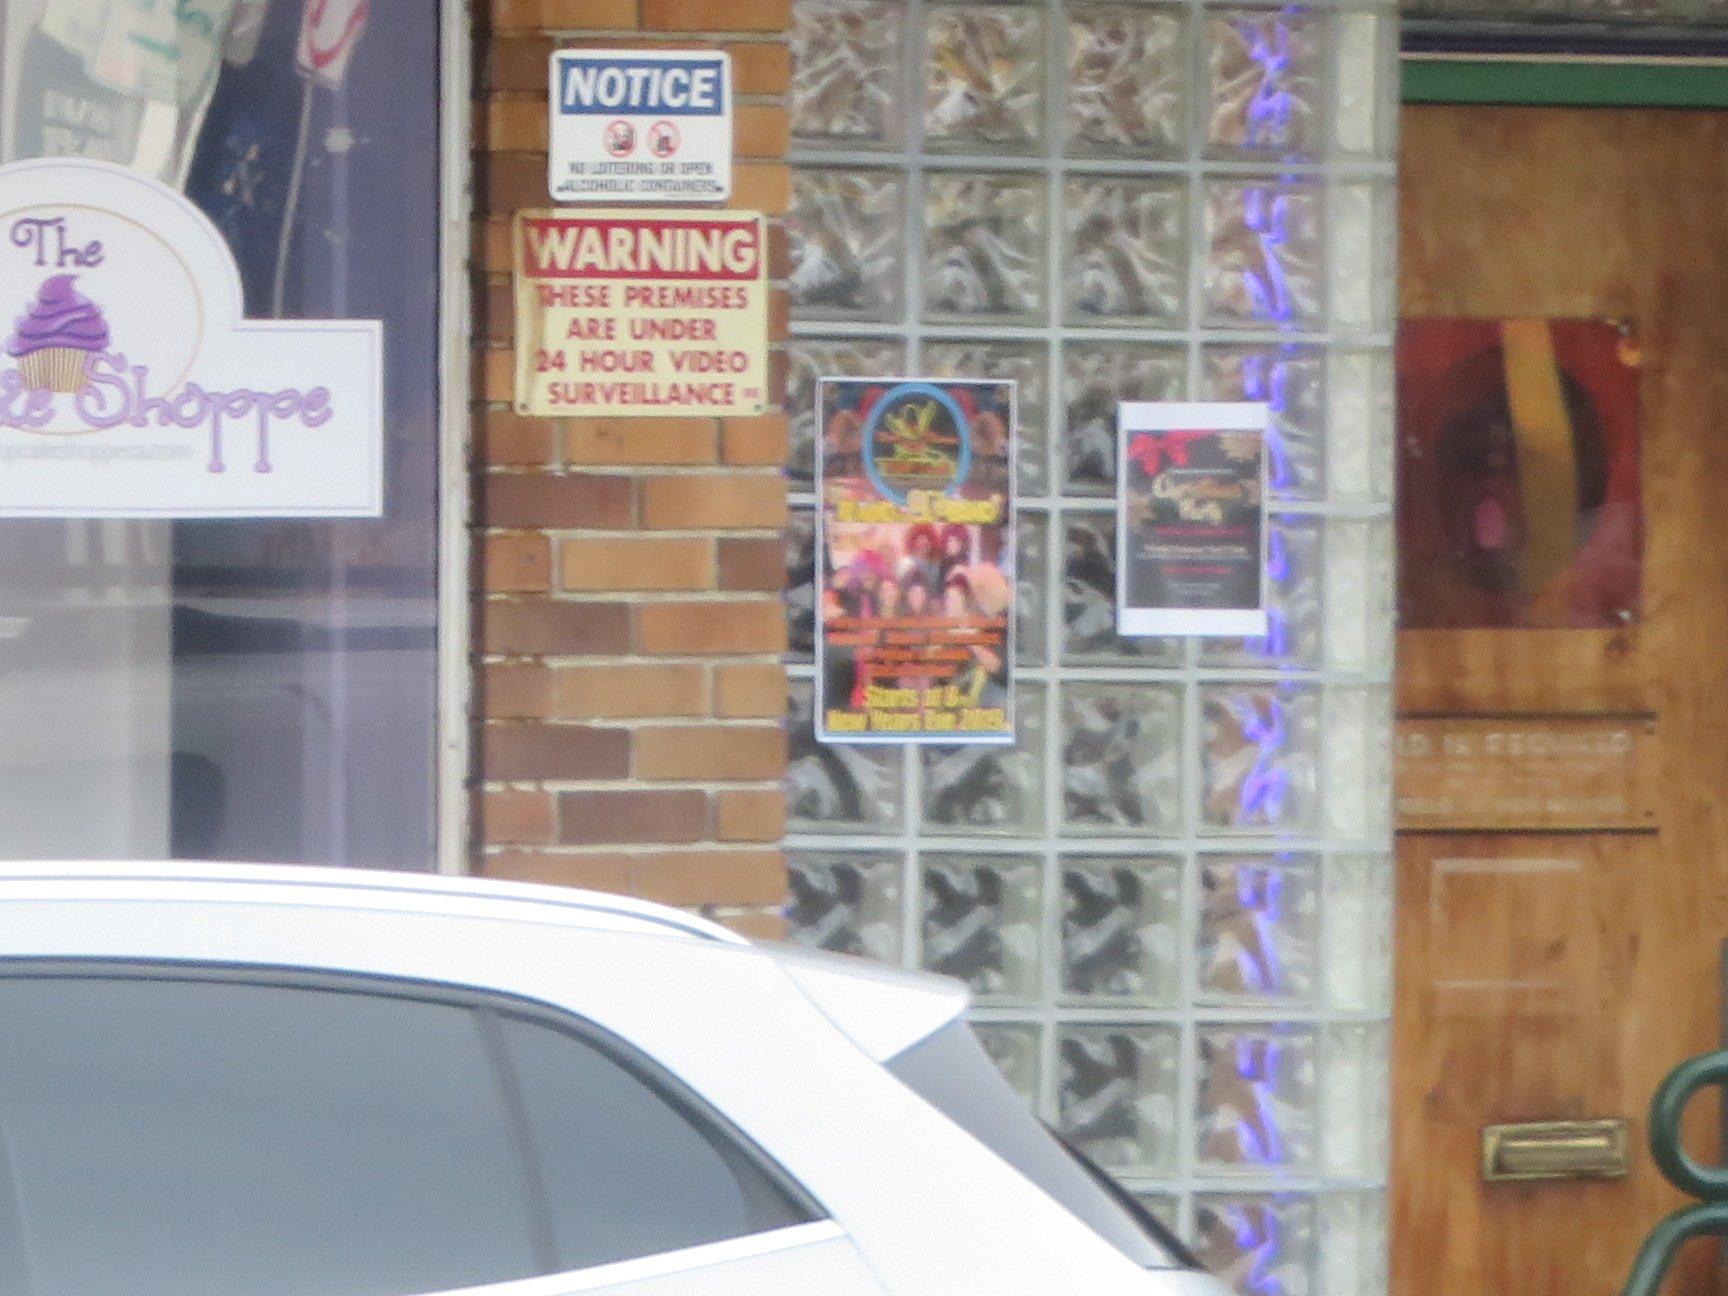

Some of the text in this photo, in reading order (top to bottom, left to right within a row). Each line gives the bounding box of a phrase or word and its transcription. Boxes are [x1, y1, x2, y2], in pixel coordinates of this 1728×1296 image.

[564, 66, 716, 109] NOTICE
[10, 217, 104, 269] The
[526, 226, 757, 274] WARNING
[536, 285, 748, 309] THESE PREMISES
[567, 318, 717, 341] ARE UNDER
[536, 350, 748, 373] 24 HOUR VIDEO
[548, 382, 736, 405] SURVEILLANCE
[74, 352, 334, 475] Shoppe
